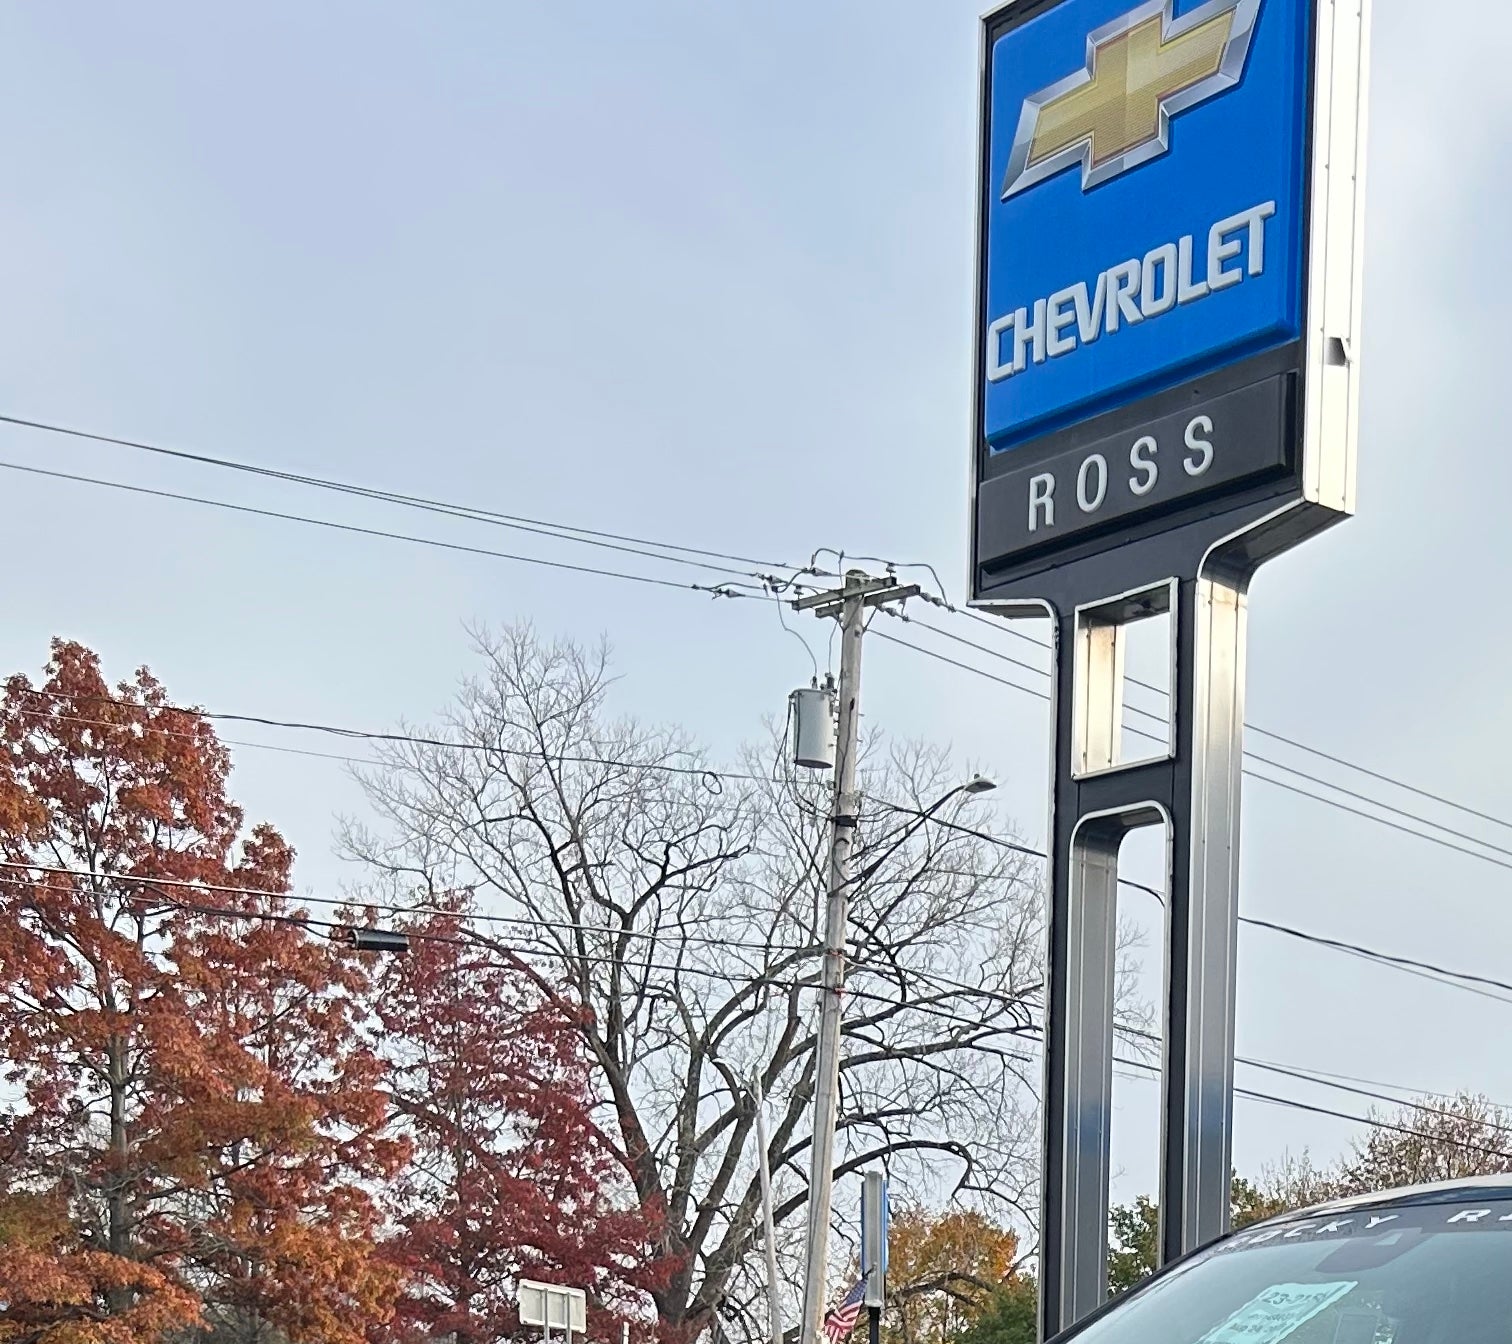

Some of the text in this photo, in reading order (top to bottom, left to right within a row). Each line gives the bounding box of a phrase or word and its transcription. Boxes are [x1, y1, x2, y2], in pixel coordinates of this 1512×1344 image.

[988, 200, 1276, 383] CHEVROLET
[1028, 415, 1215, 532] ROSS
[1217, 1214, 1400, 1252] ROCKY
